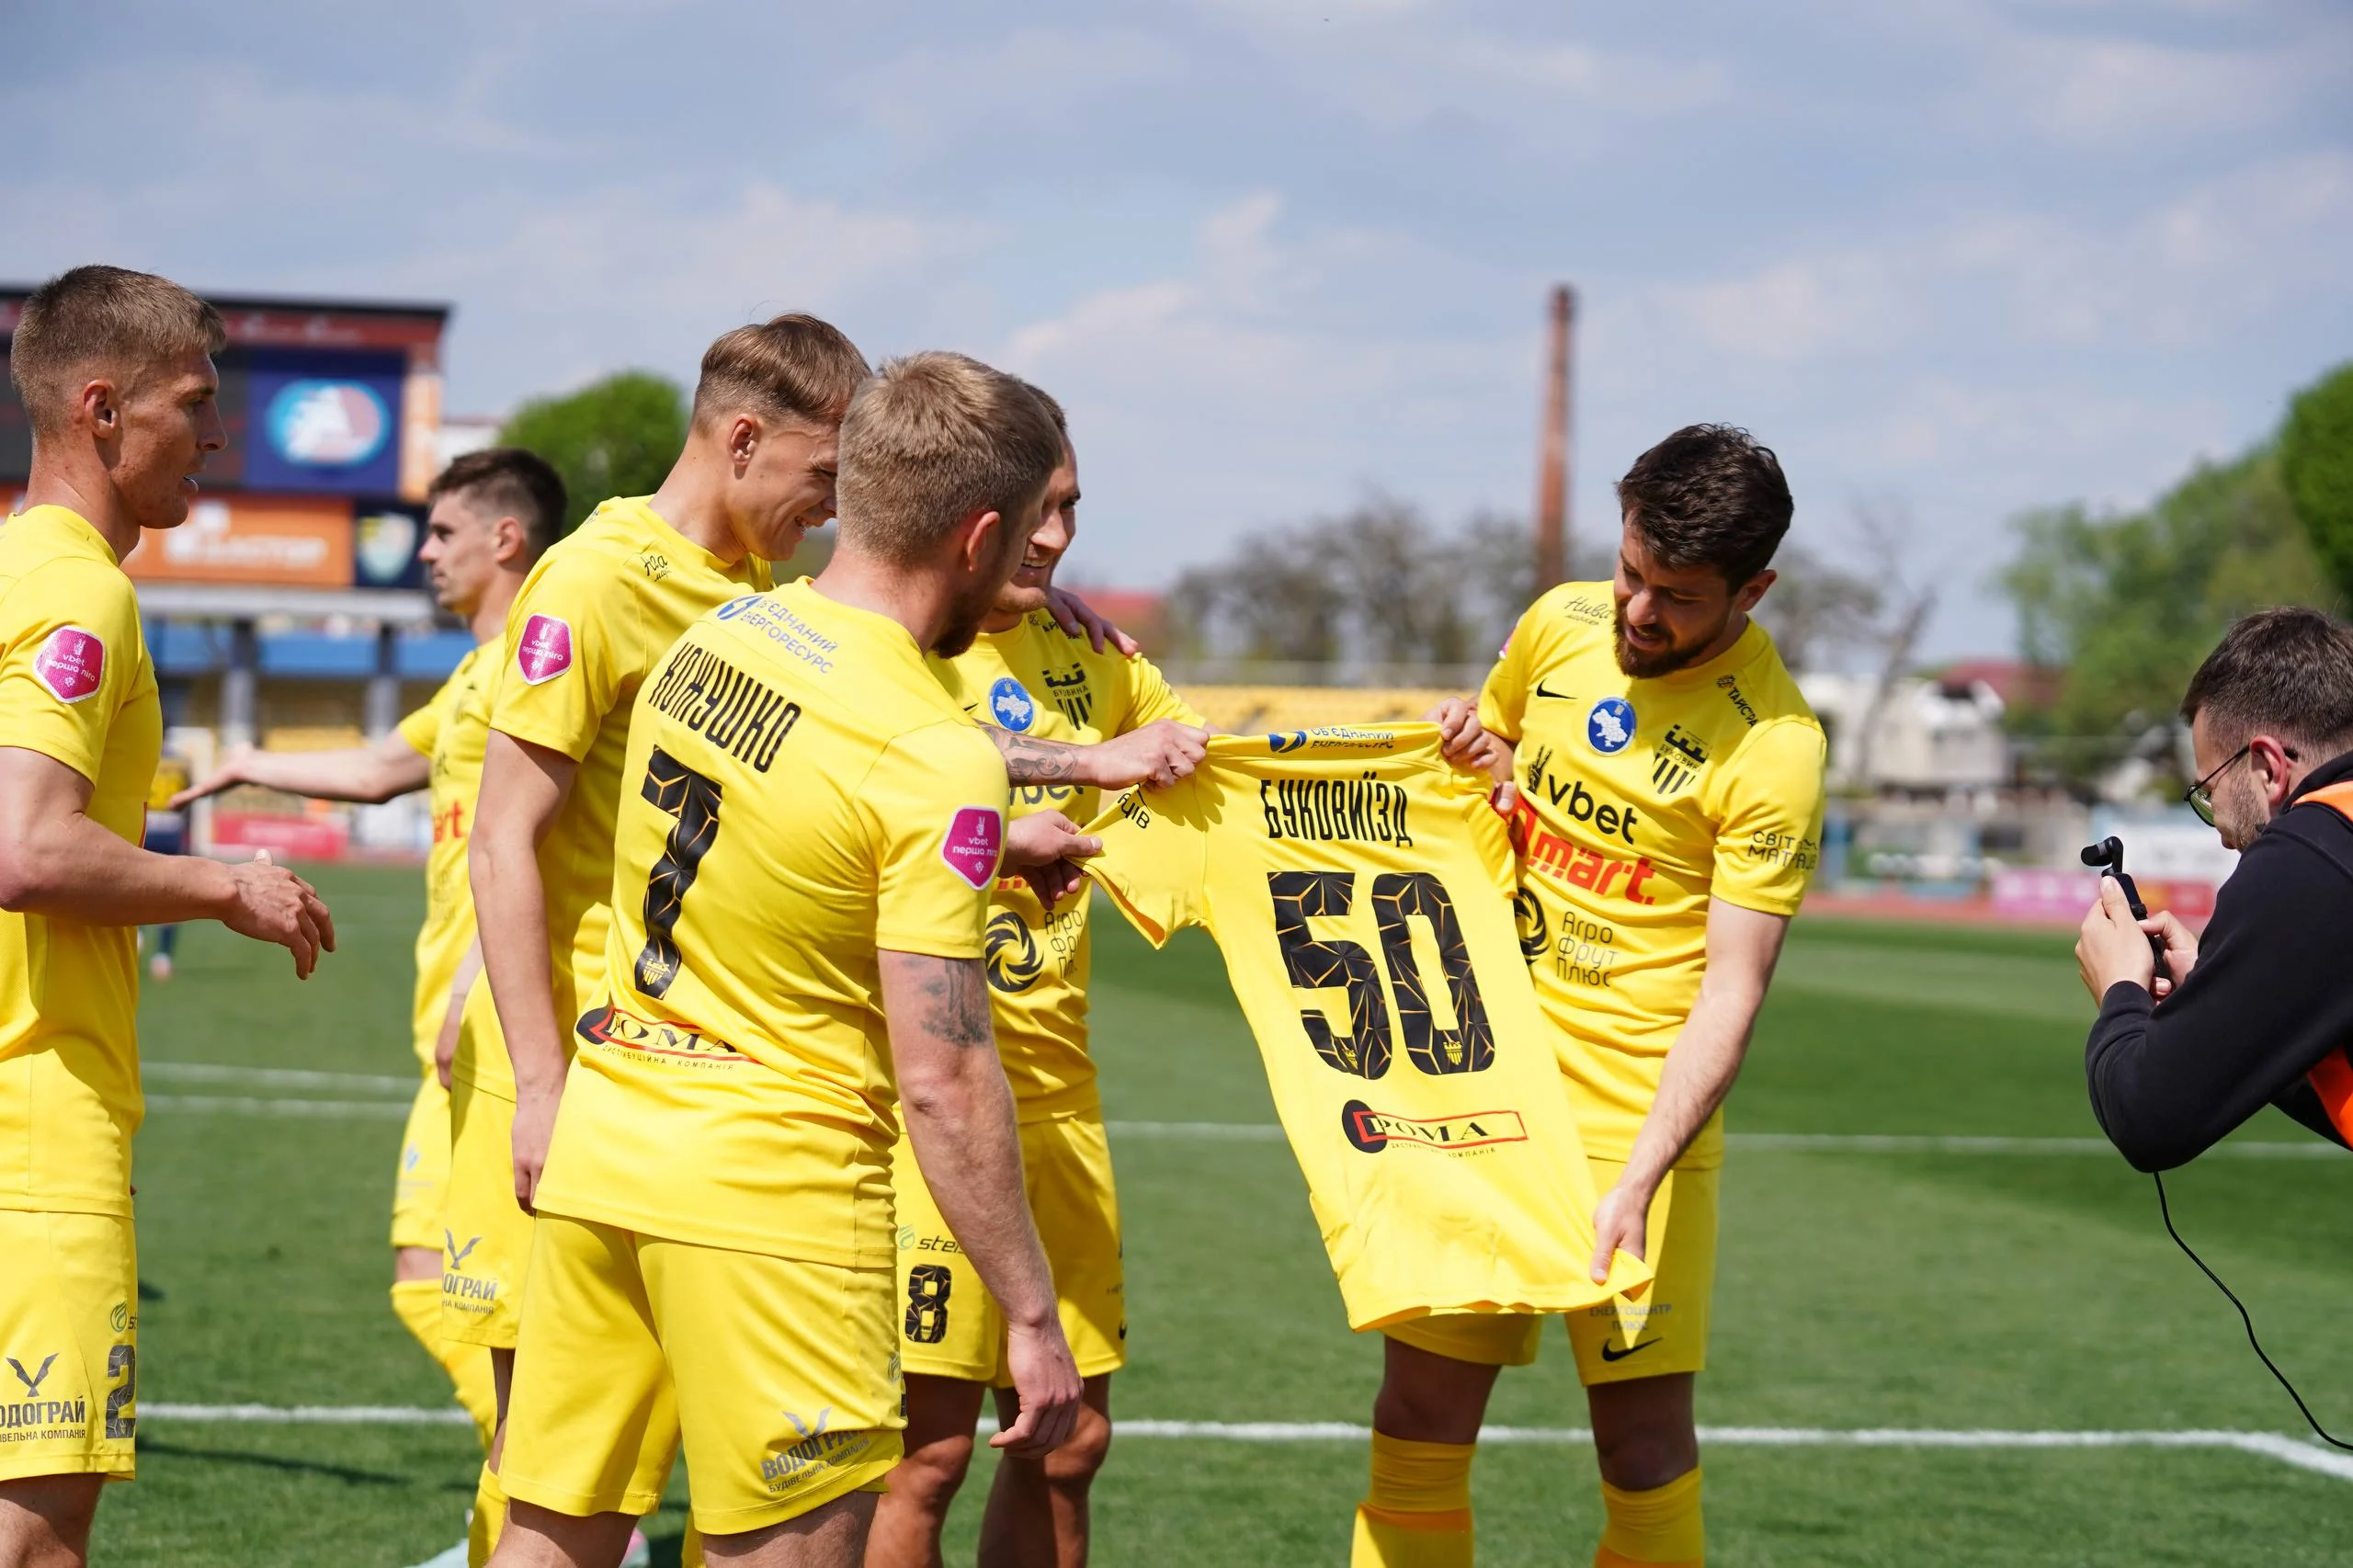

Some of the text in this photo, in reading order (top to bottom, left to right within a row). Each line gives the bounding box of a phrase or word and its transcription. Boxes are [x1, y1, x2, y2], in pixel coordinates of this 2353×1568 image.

[63, 653, 85, 667] vbet
[648, 642, 802, 774] КОЖУШКО
[1260, 770, 1414, 848] БУКОВИЇЗД
[1548, 773, 1638, 846] vbet
[968, 835, 990, 846] vbet
[1753, 830, 1796, 849] СВІТ
[641, 744, 723, 1001] 7
[1044, 910, 1084, 936] Агро
[1562, 911, 1614, 944] Агро
[1557, 935, 1620, 970] Фрут
[1266, 870, 1496, 1081] 50
[1556, 956, 1611, 987] Плюс
[676, 1061, 733, 1071] КОМПАНІЯ
[1366, 1117, 1491, 1142] РОМА
[904, 1263, 952, 1344] 8
[106, 1344, 136, 1438] 2
[40, 1428, 85, 1440] КОМПАНІЯ
